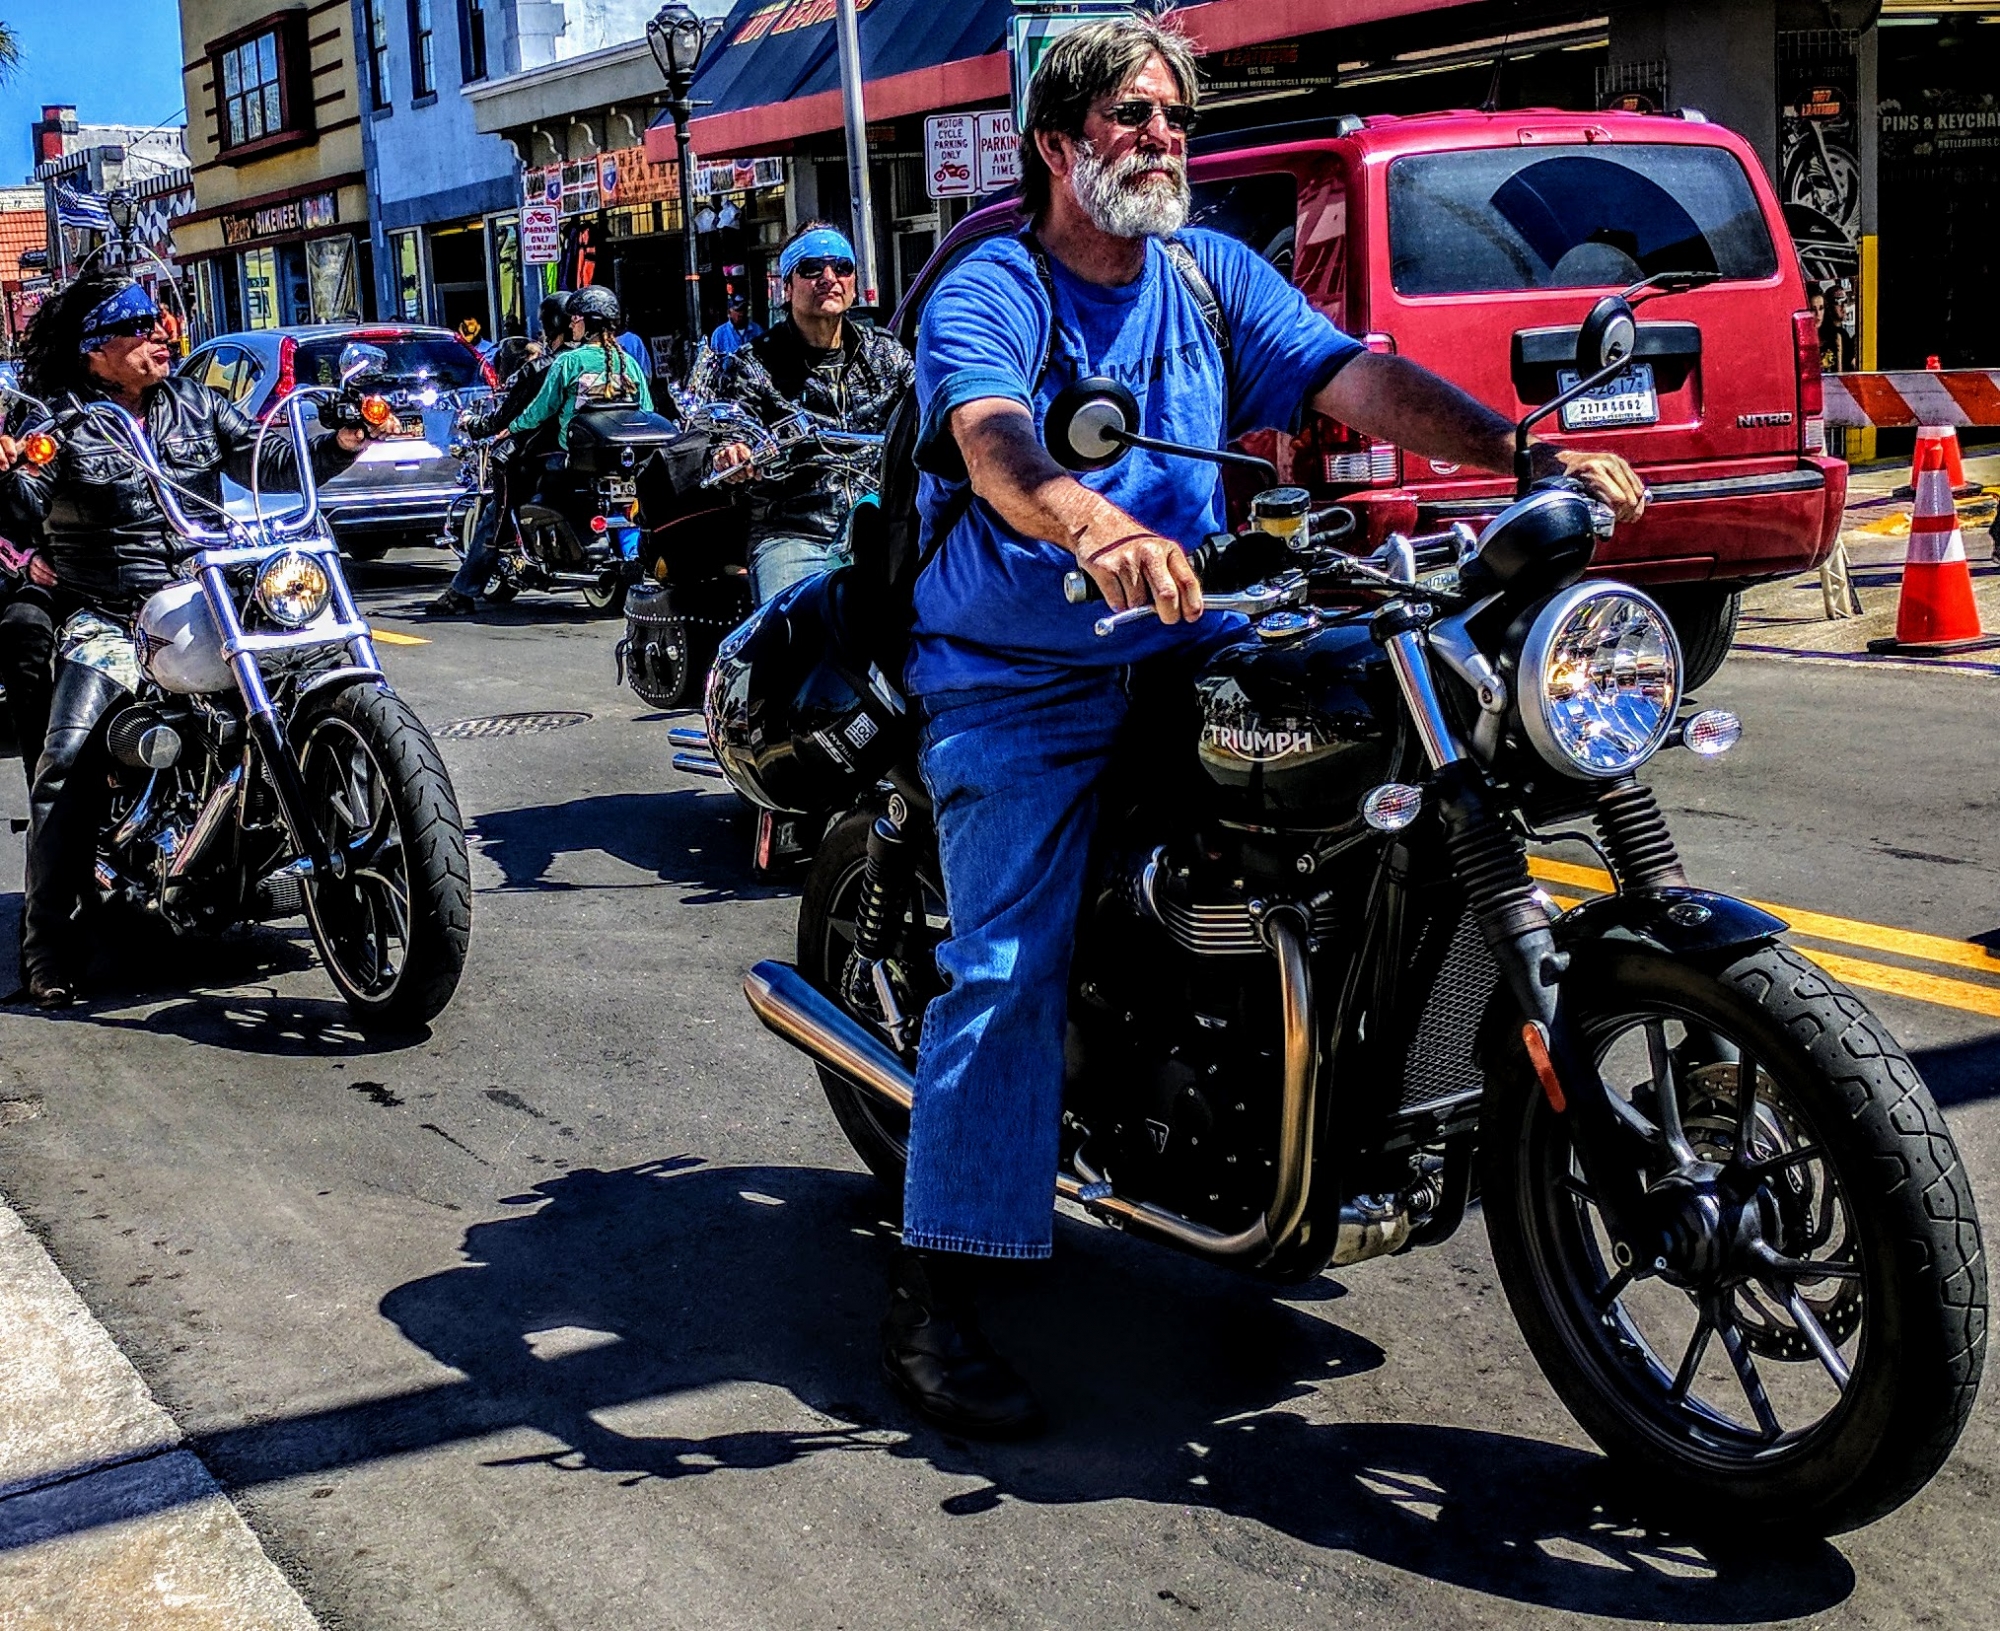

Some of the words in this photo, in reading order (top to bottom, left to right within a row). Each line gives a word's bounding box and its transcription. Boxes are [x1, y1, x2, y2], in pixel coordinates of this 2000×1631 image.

[1250, 79, 1299, 88] MOTORCYCLE
[937, 118, 964, 129] MOTOR
[992, 118, 1011, 133] NO
[1882, 114, 1919, 131] PINS
[1923, 117, 1934, 130] &
[938, 129, 964, 139] CYCLE
[934, 139, 968, 150] PARKING
[981, 136, 1021, 152] PARKIN
[941, 150, 962, 160] ONLY
[992, 152, 1013, 164] ANY
[991, 165, 1015, 175] TIME
[531, 236, 550, 244] ONLY
[1737, 412, 1793, 428] NITRO
[1210, 724, 1313, 755] TRIUMPH
